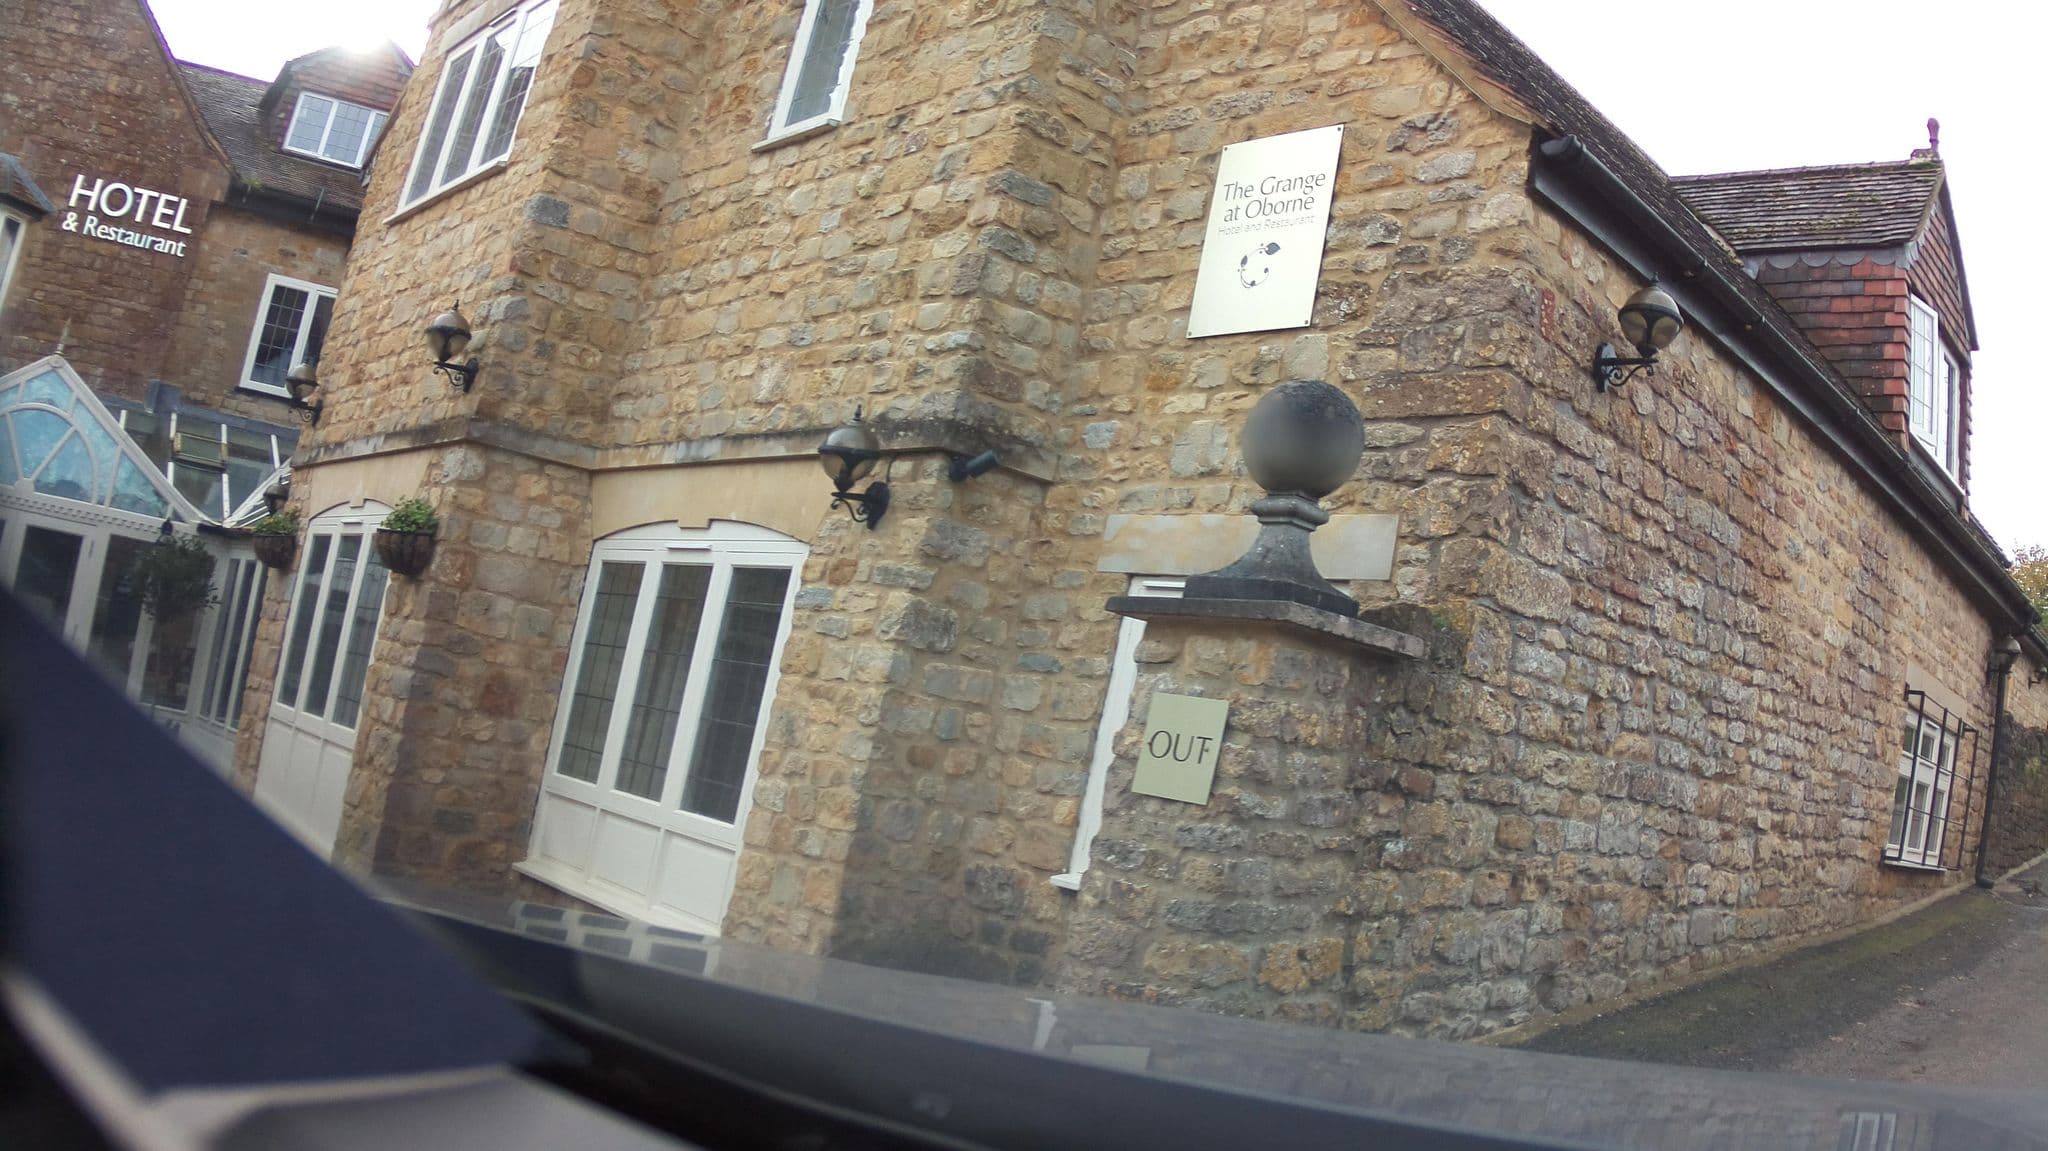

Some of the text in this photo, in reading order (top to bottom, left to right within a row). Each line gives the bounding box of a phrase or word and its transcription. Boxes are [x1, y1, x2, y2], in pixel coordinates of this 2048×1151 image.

[1224, 173, 1326, 201] The Grange
[69, 174, 192, 234] HOTEL
[1223, 196, 1314, 222] at Oborne
[62, 212, 187, 257] & Restaurant
[1218, 215, 1315, 236] Hotel and Restaurant
[1149, 730, 1213, 765] OUT
